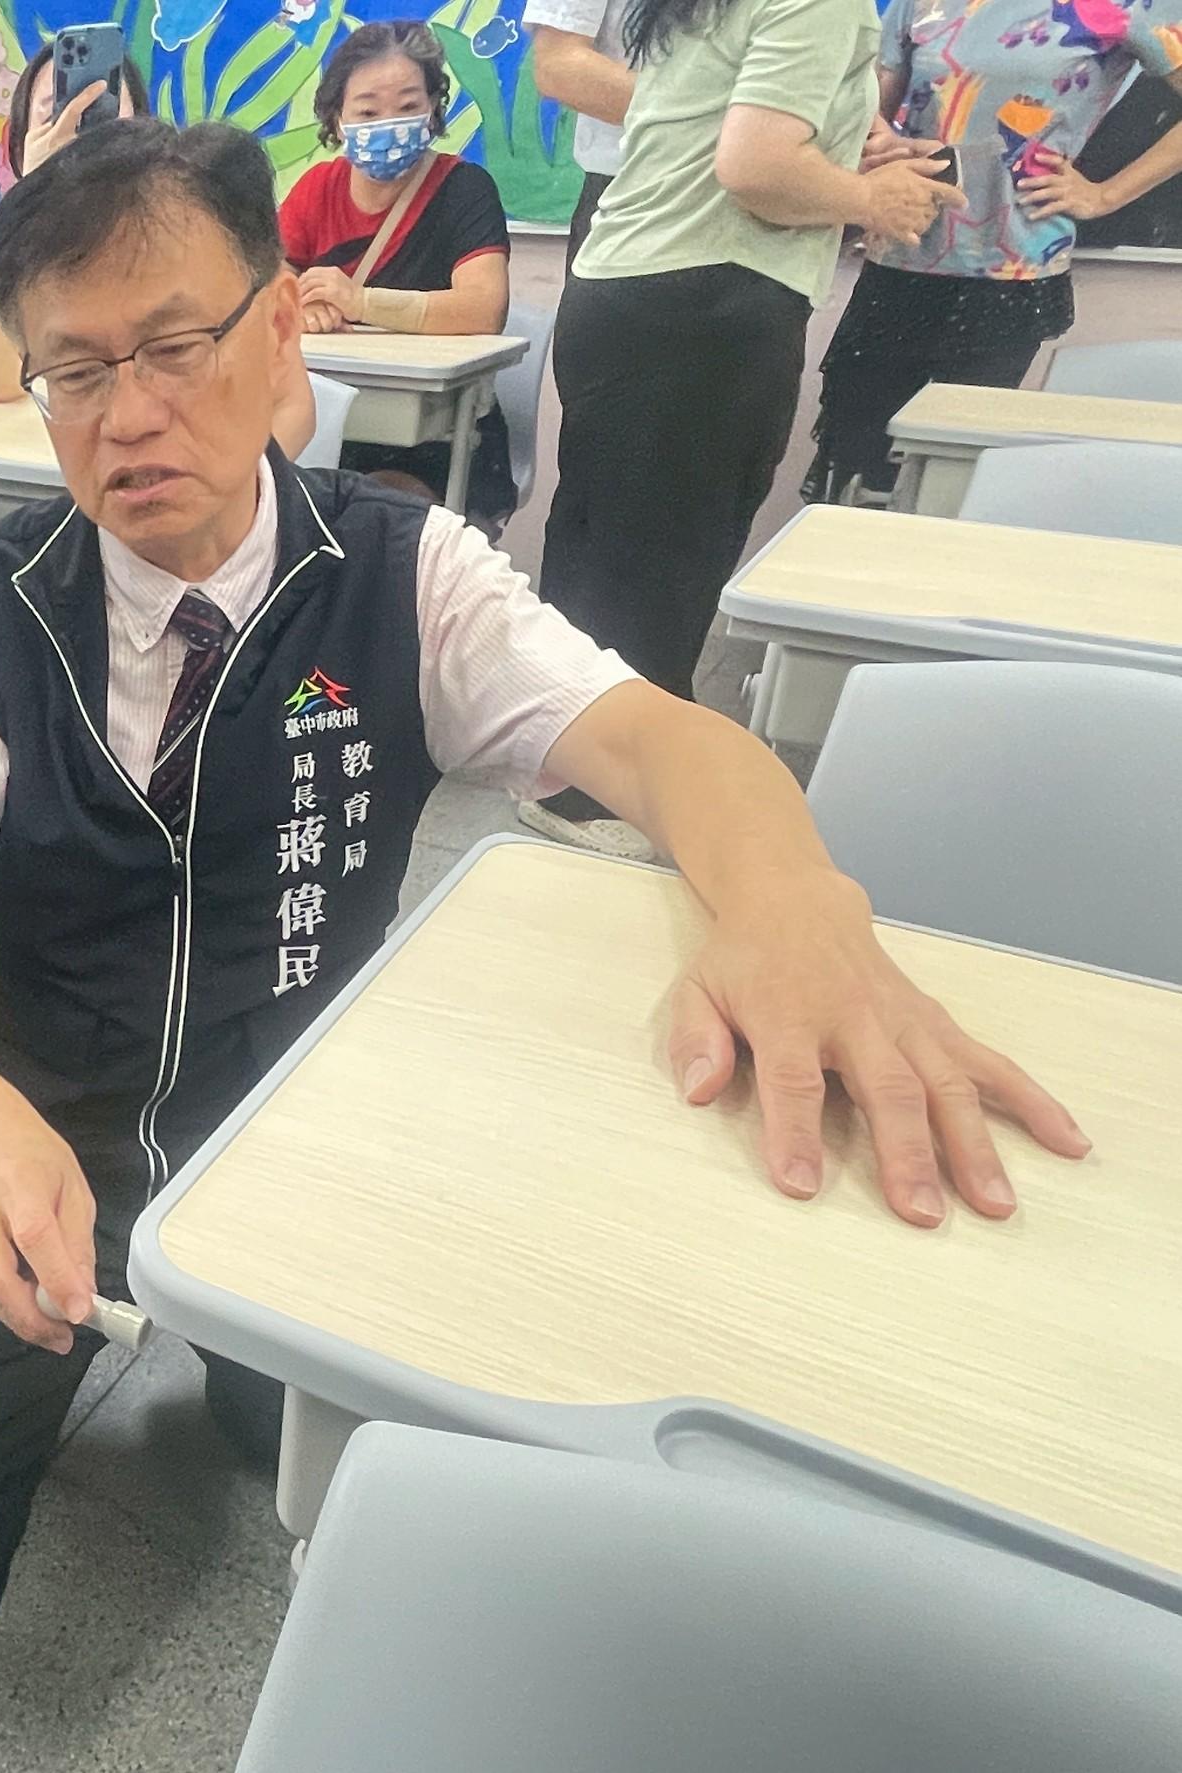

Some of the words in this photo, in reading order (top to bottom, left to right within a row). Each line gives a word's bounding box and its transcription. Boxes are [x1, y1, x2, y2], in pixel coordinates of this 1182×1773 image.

[284, 707, 359, 739] 臺中市政府
[341, 740, 374, 878] 教育局
